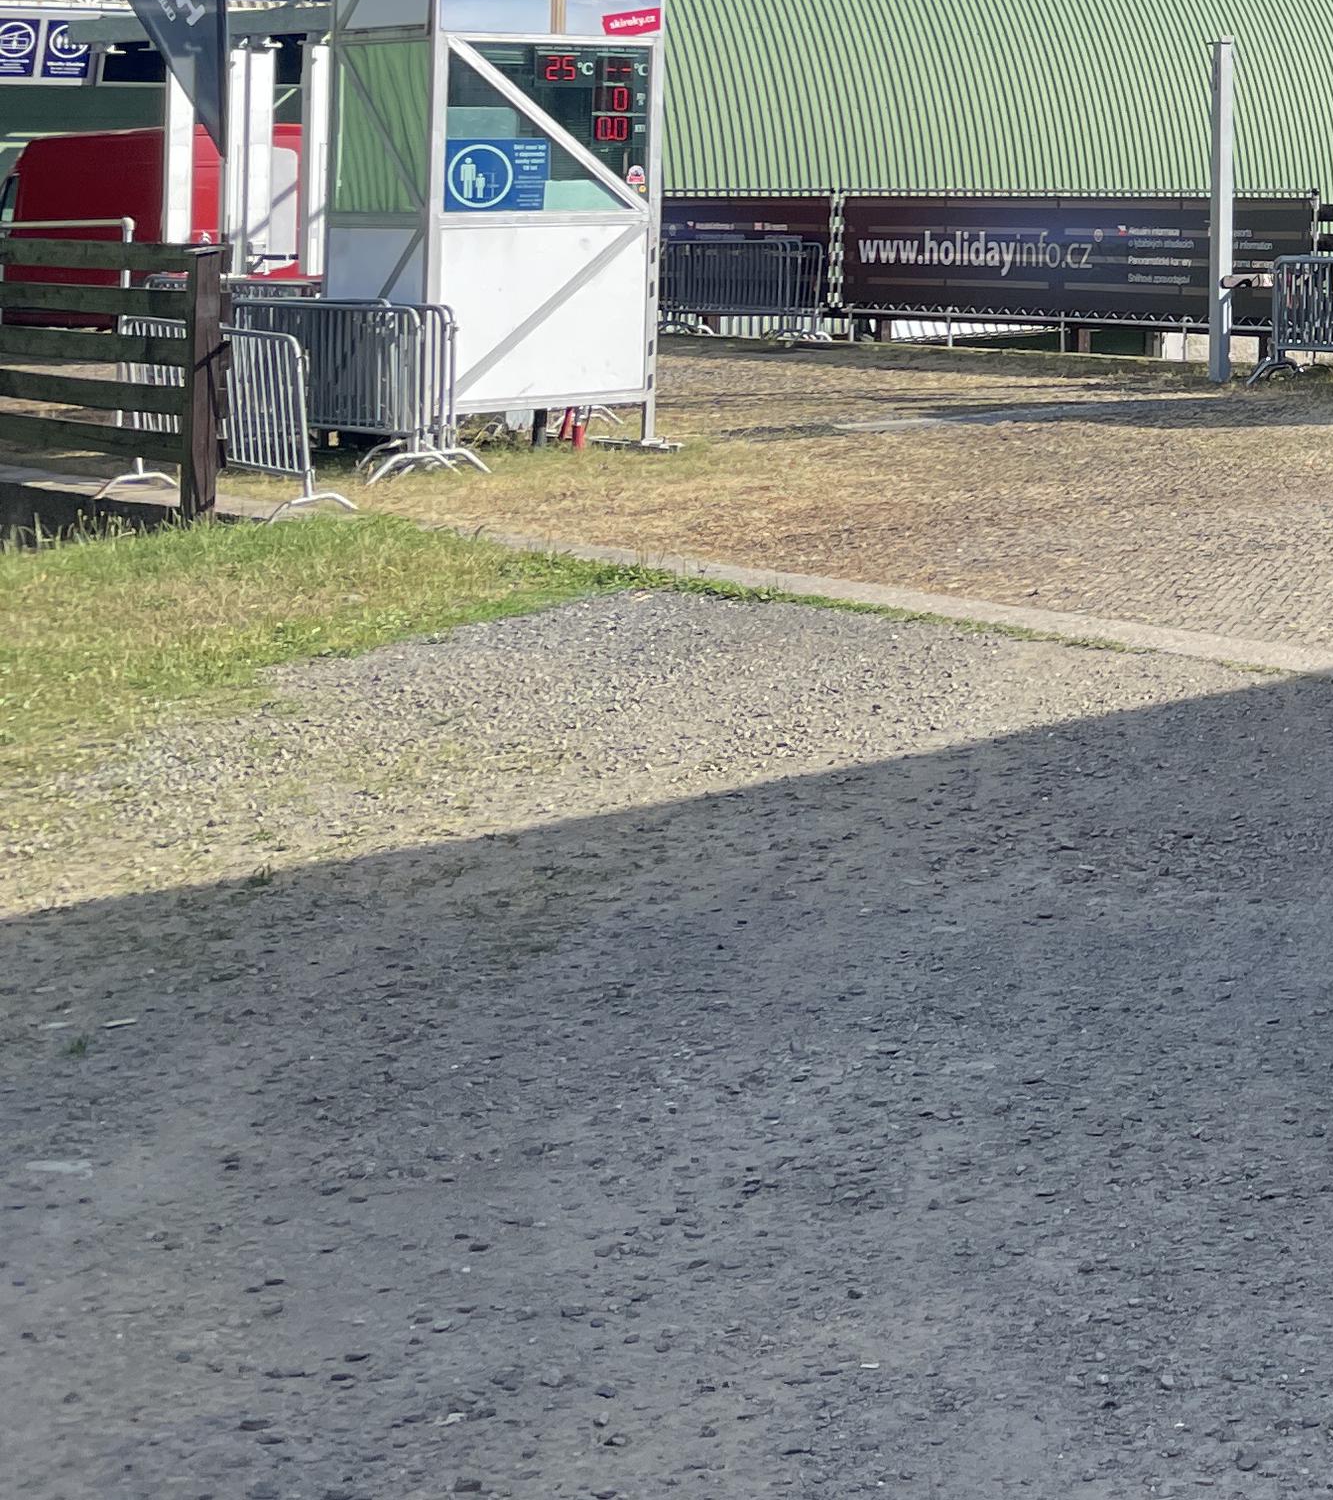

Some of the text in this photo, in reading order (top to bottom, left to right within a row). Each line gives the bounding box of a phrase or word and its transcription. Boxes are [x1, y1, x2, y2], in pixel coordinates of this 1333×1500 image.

[545, 55, 576, 81] 25
[613, 86, 628, 111] 0
[858, 229, 1093, 277] www.holidayinfo.cz
